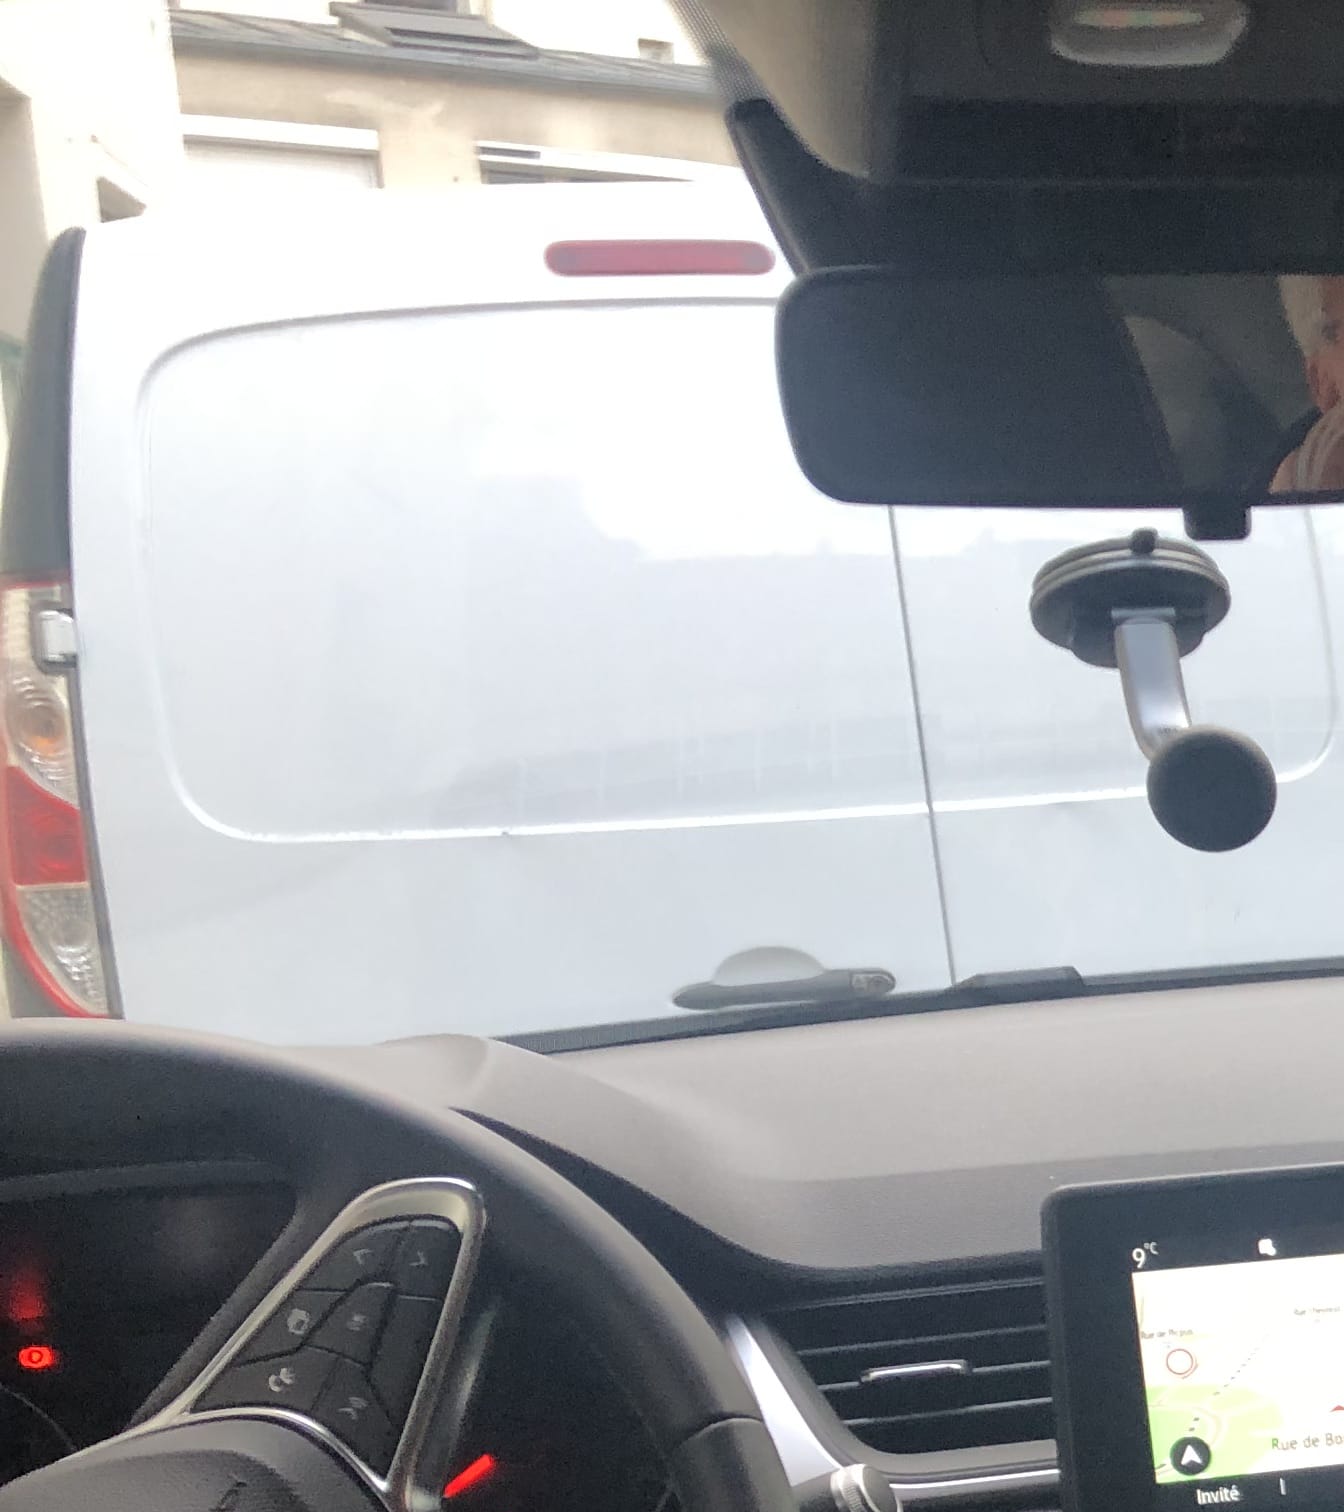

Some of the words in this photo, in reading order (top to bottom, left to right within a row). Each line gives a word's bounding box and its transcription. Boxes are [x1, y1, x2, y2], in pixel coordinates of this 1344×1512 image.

[1271, 1437, 1298, 1453] Rue
[1302, 1433, 1320, 1449] de
[1196, 1484, 1241, 1506] Invité
